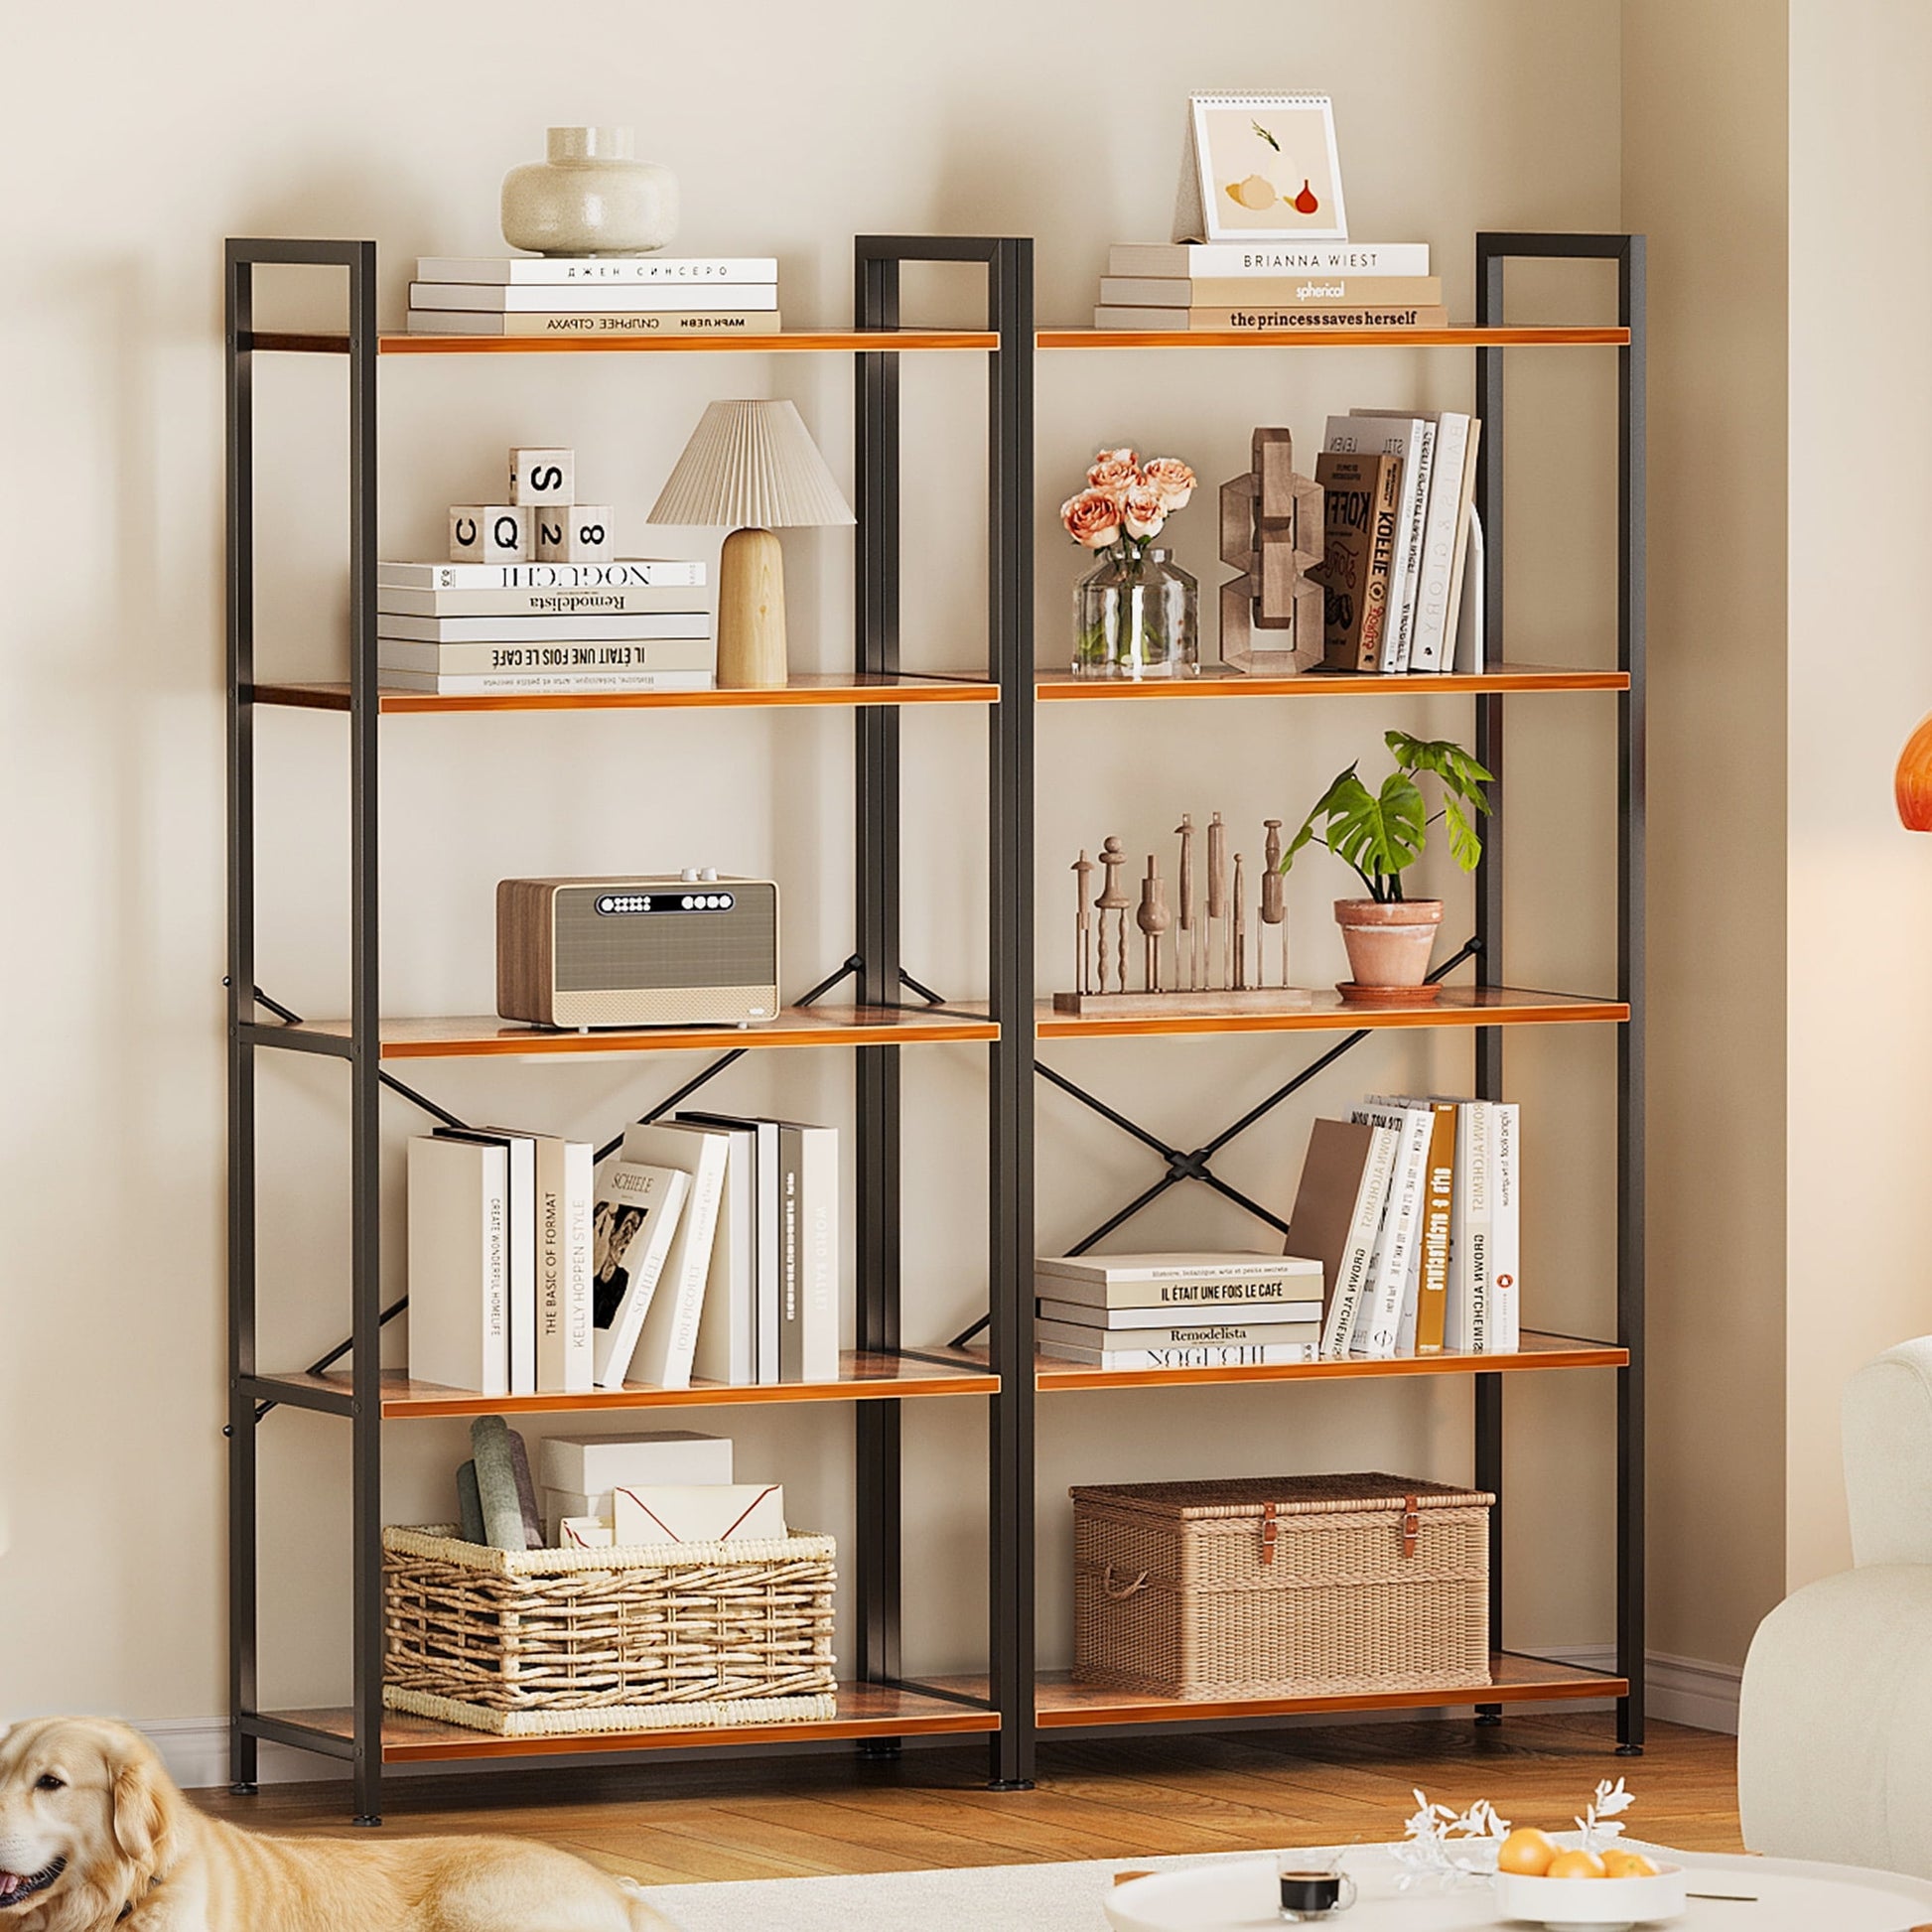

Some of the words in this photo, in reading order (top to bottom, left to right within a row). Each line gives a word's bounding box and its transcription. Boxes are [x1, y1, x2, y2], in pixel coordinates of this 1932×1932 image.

[1243, 254, 1319, 268] BRIANNA
[1328, 253, 1378, 267] WIEST
[568, 266, 621, 278] ДЖЕН
[636, 265, 728, 277] СИНСЕРО
[1296, 280, 1345, 301] spherical
[1230, 312, 1256, 327] the
[1258, 312, 1321, 330] princess
[1322, 313, 1363, 327] saves
[1364, 311, 1418, 326] herself
[530, 466, 563, 491] S
[456, 518, 477, 546] C
[494, 516, 518, 550] Q
[541, 523, 562, 545] 2
[580, 524, 605, 545] 8
[502, 566, 651, 588] NOGUCHI
[529, 595, 625, 611] Remodelista
[491, 649, 523, 670] CAFÉ
[524, 649, 539, 667] LE
[542, 648, 569, 666] FOIS
[572, 648, 596, 665] UNE
[599, 647, 631, 667] ÉTAIT
[634, 646, 645, 664] IL
[612, 1172, 654, 1193] SCHIELE
[490, 1197, 500, 1230] CREATE
[545, 1191, 556, 1244] FORMAT
[573, 1199, 584, 1240] STYLE
[545, 1249, 556, 1266] OF
[573, 1245, 584, 1301] HOPPEN
[545, 1270, 556, 1307] BASIC
[1161, 1288, 1170, 1302] IL
[1172, 1284, 1198, 1301] ÉTAIT
[1199, 1286, 1220, 1300] UNE
[1222, 1285, 1243, 1299] FOIS
[1245, 1284, 1257, 1299] LE
[1258, 1282, 1284, 1298] CAFÉ
[490, 1292, 500, 1335] HOMELIFE
[545, 1311, 556, 1334] THE
[573, 1306, 584, 1347] KELLY
[1170, 1327, 1247, 1342] Remodelista
[1146, 1345, 1265, 1367] NOGUCHI
